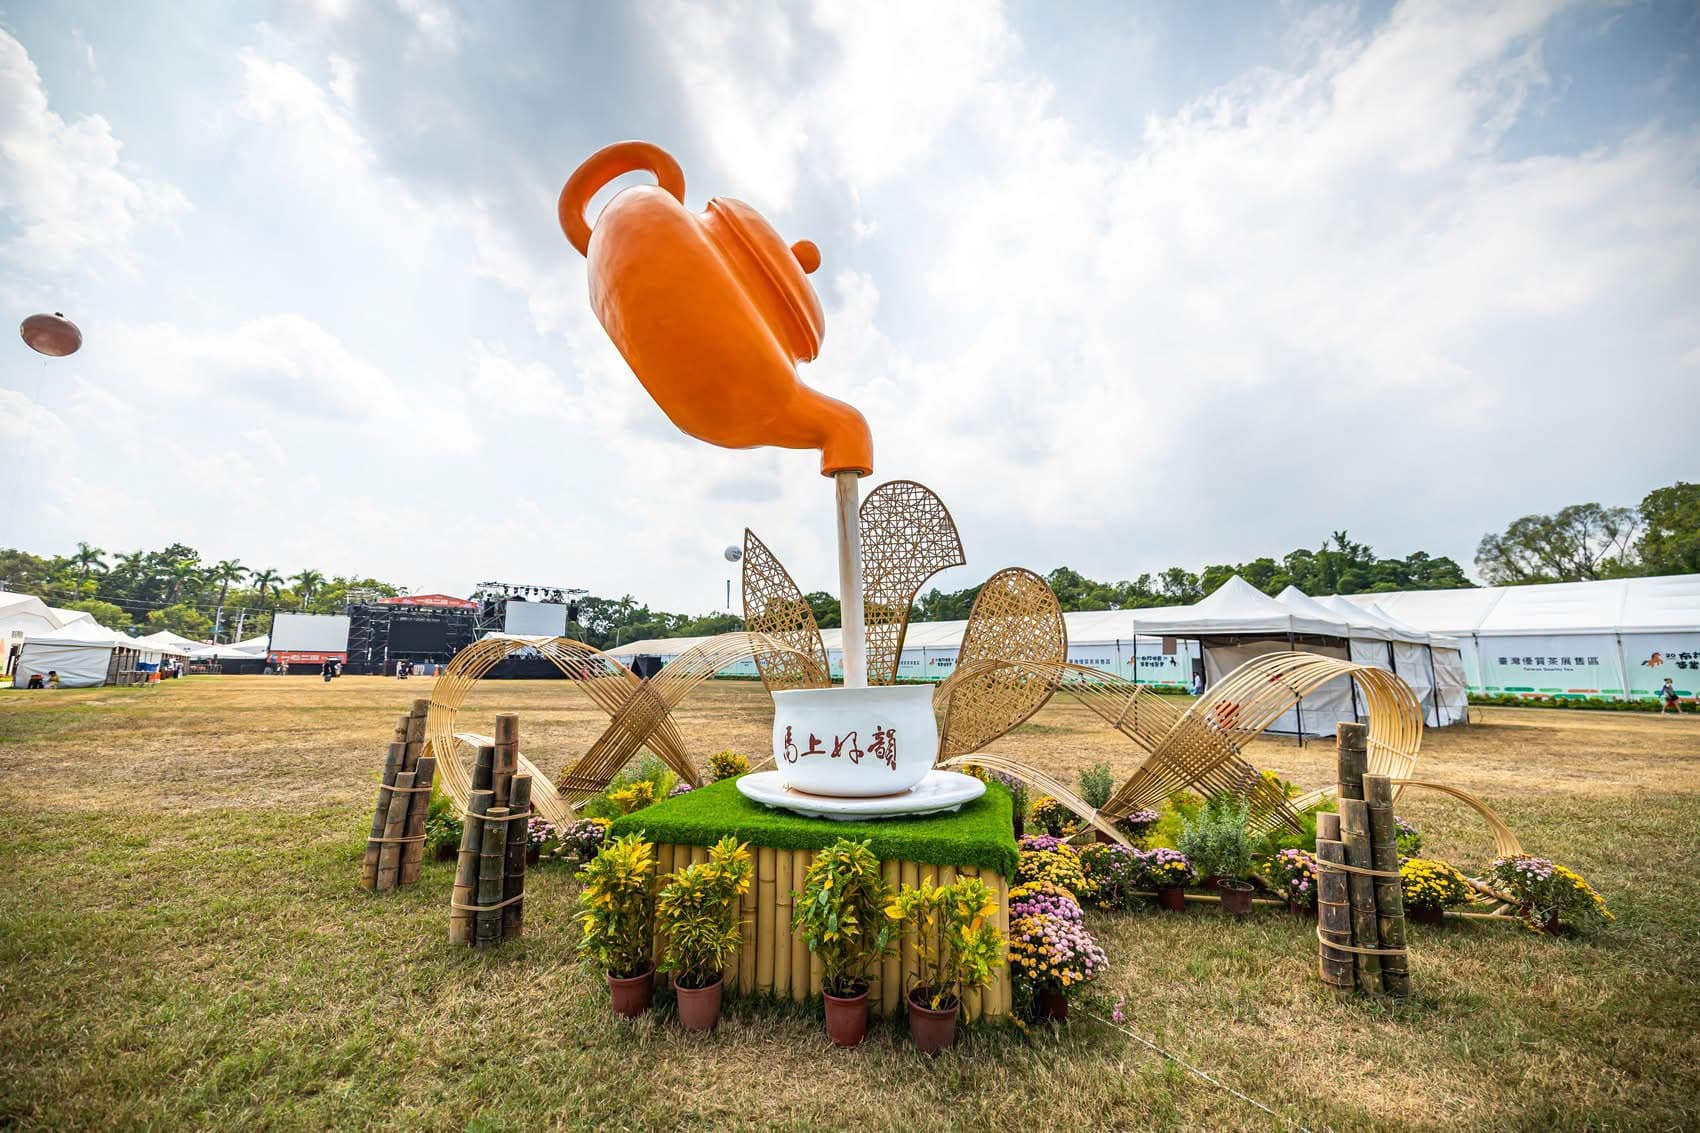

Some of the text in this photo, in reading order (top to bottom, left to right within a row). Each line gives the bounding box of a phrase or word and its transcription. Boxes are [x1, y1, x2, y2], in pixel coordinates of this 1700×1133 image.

[1498, 656, 1600, 666] 臺灣優質茶展售區
[783, 725, 897, 771] 馬上好韻
